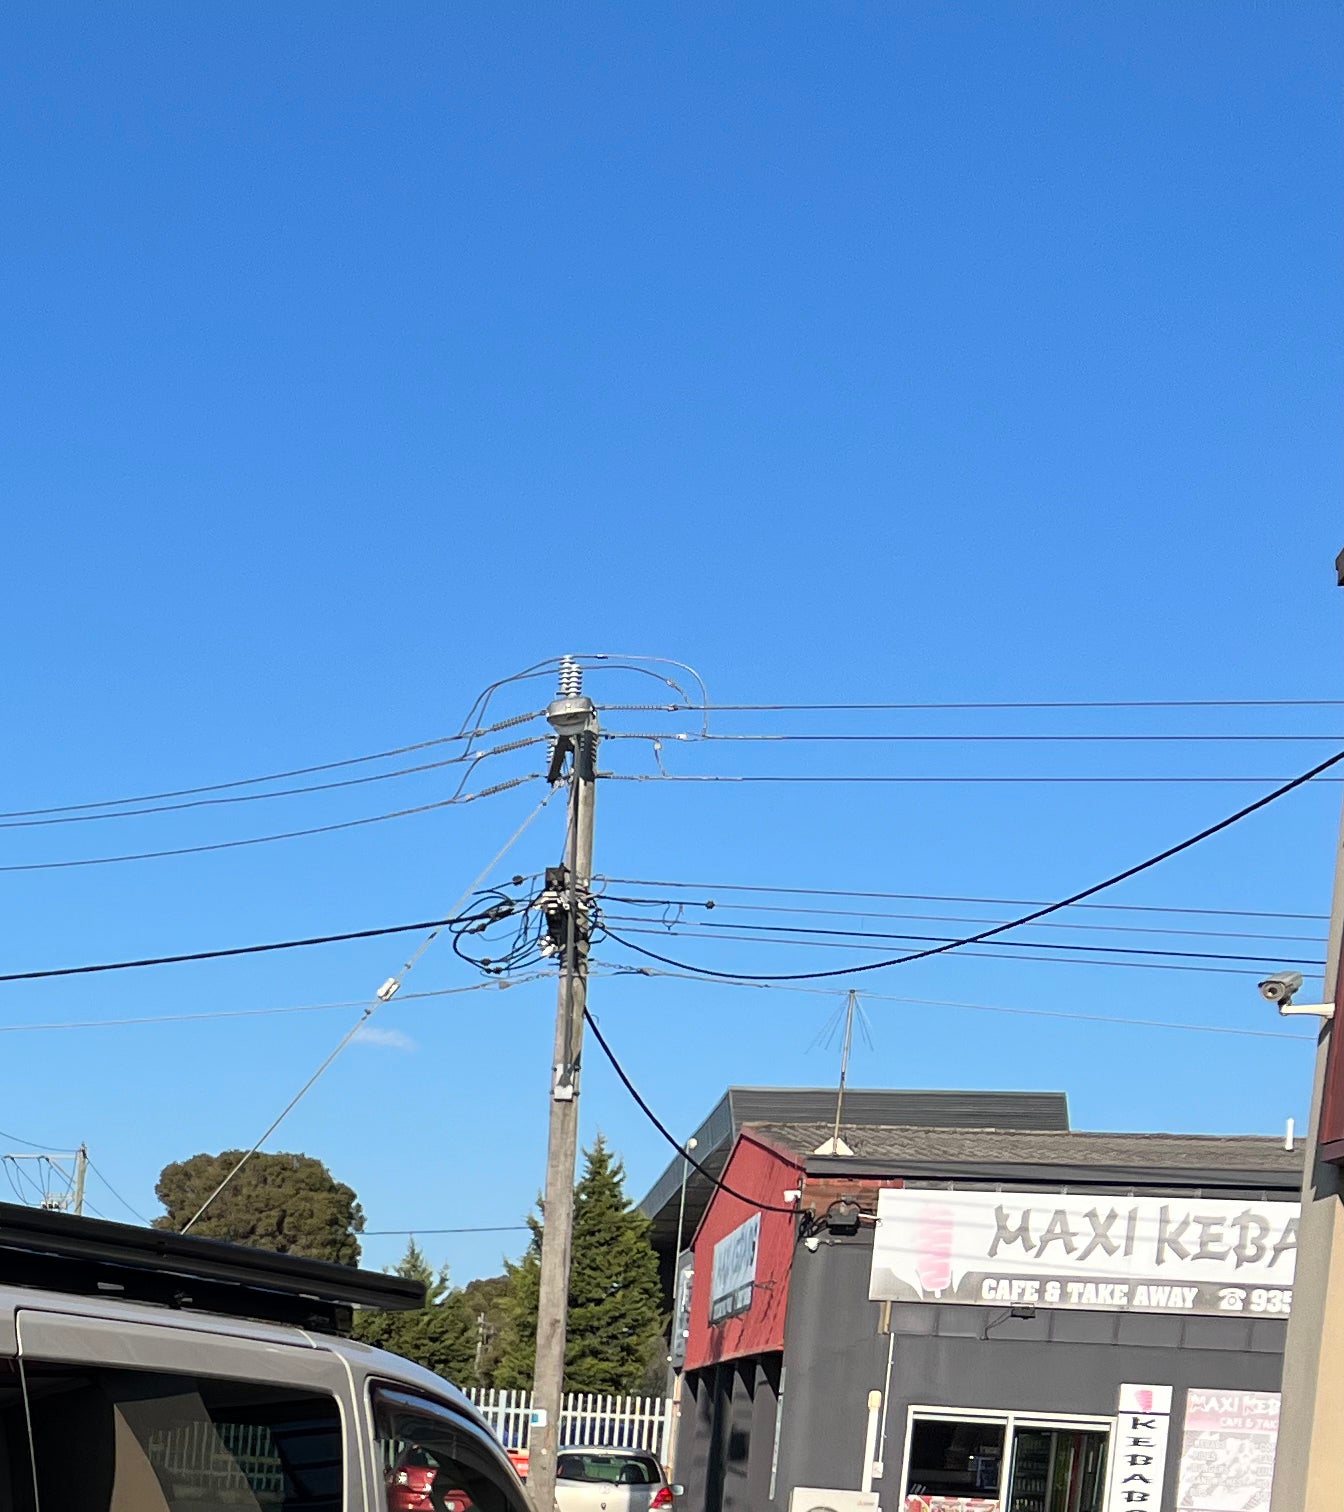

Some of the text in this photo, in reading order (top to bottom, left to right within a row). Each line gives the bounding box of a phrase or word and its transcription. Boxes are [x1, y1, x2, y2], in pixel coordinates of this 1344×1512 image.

[987, 1204, 1140, 1261] MAXI
[981, 1278, 1039, 1301] CAFE
[1045, 1280, 1061, 1301] &
[1066, 1282, 1128, 1305] TAKE
[1133, 1285, 1199, 1308] AWAY
[1189, 1393, 1239, 1413] MAXI
